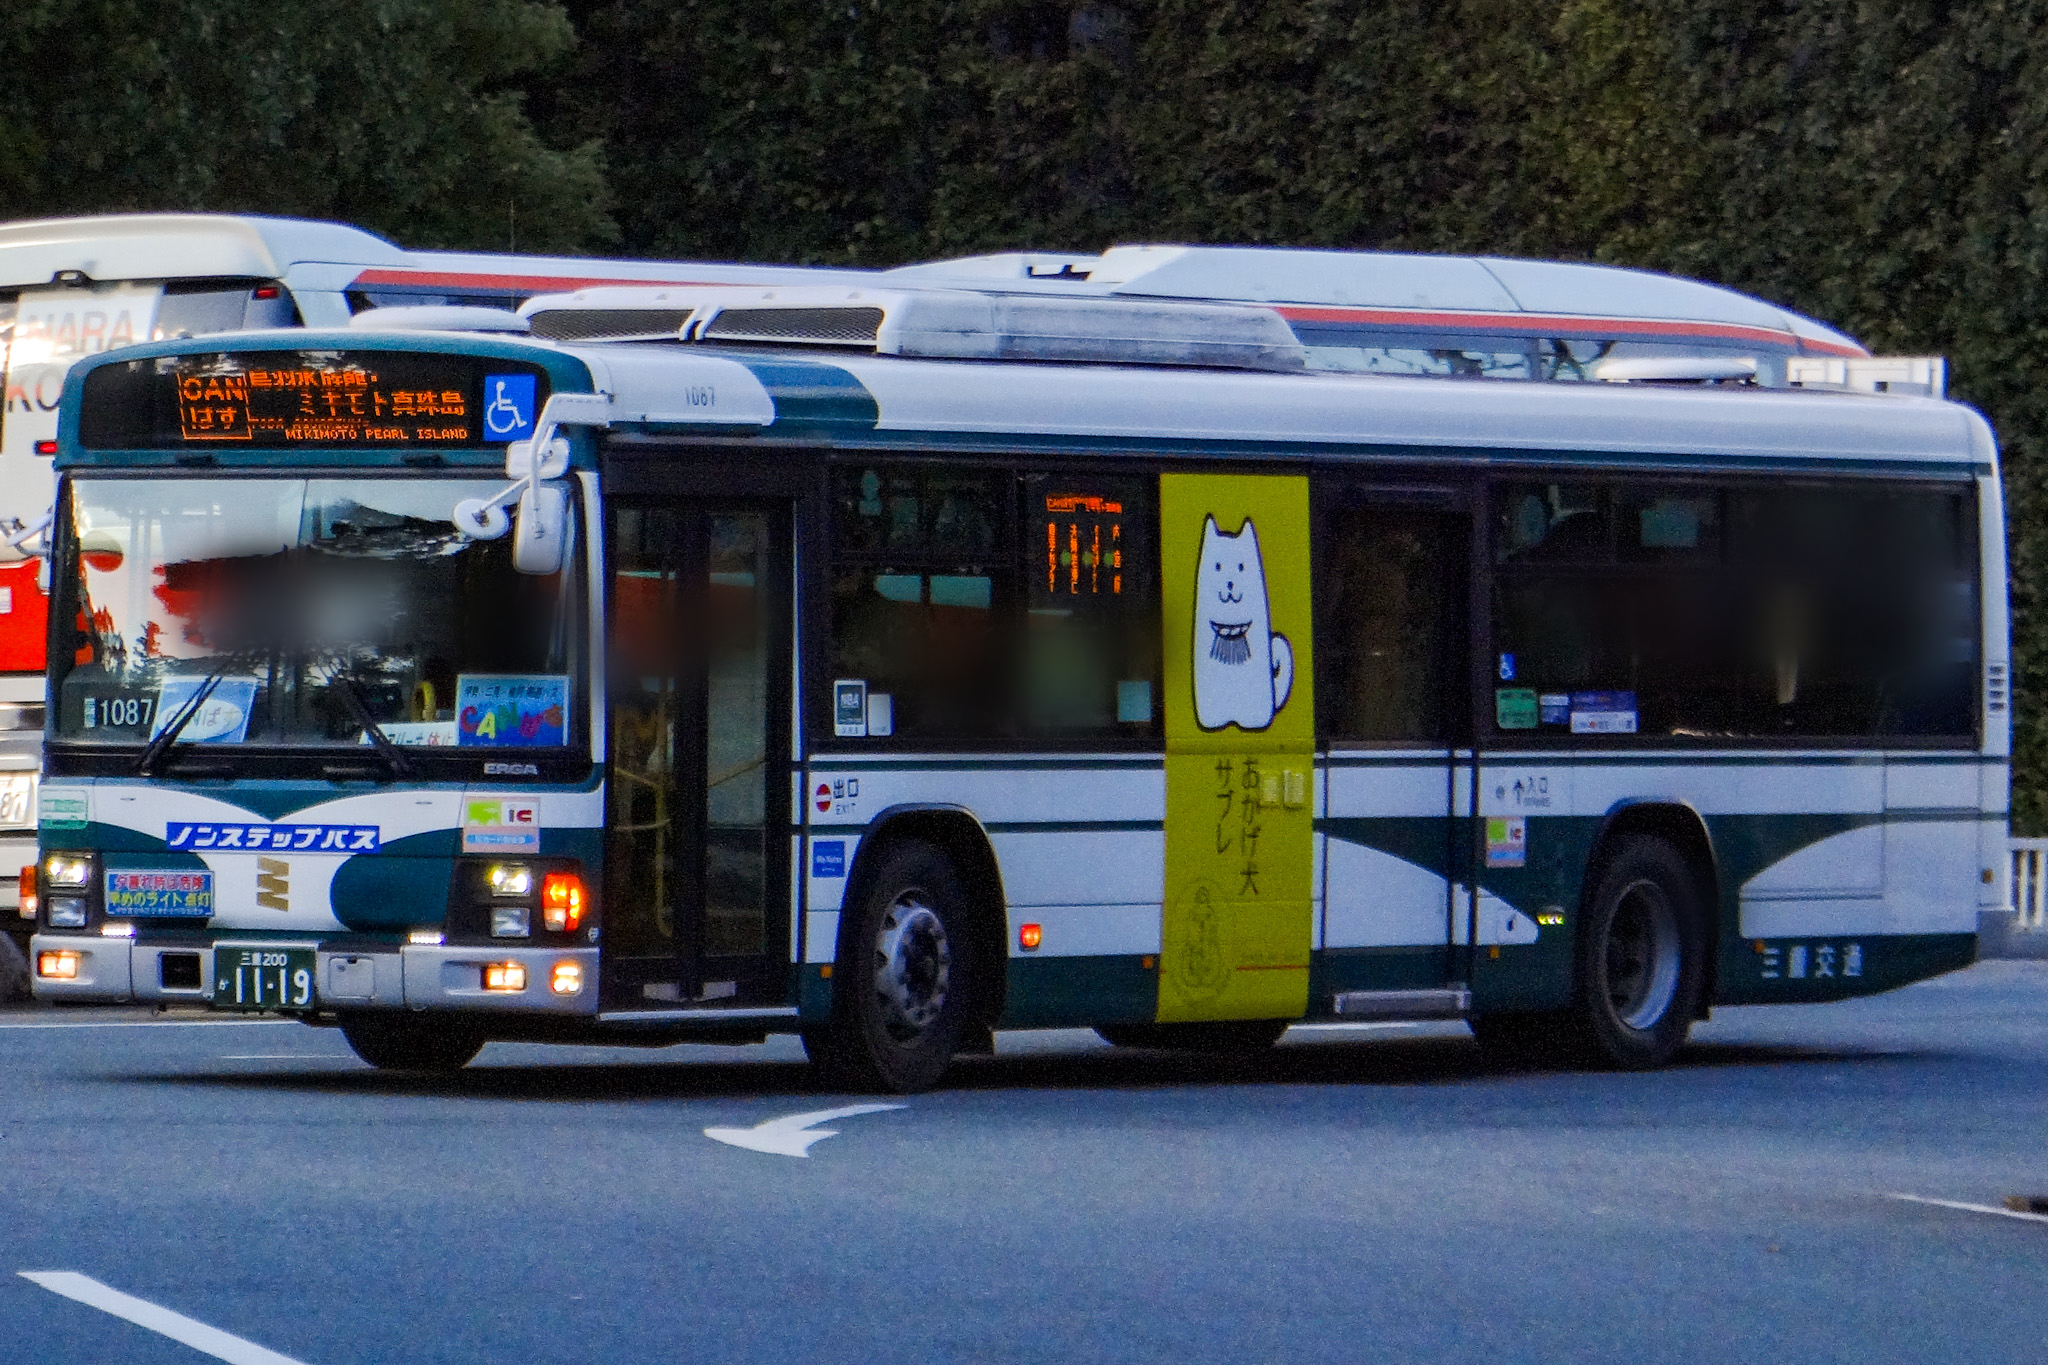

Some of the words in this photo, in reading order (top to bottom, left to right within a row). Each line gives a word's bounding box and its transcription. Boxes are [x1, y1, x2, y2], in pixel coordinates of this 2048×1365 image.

[183, 378, 243, 401] CAN
[285, 428, 357, 440] MIKIMOTO
[365, 428, 409, 440] PEARL
[416, 428, 468, 440] ISLAND
[100, 698, 153, 726] 1087
[484, 762, 538, 776] ERGA
[833, 778, 859, 799] 出口
[170, 826, 377, 850] ノンステップバス
